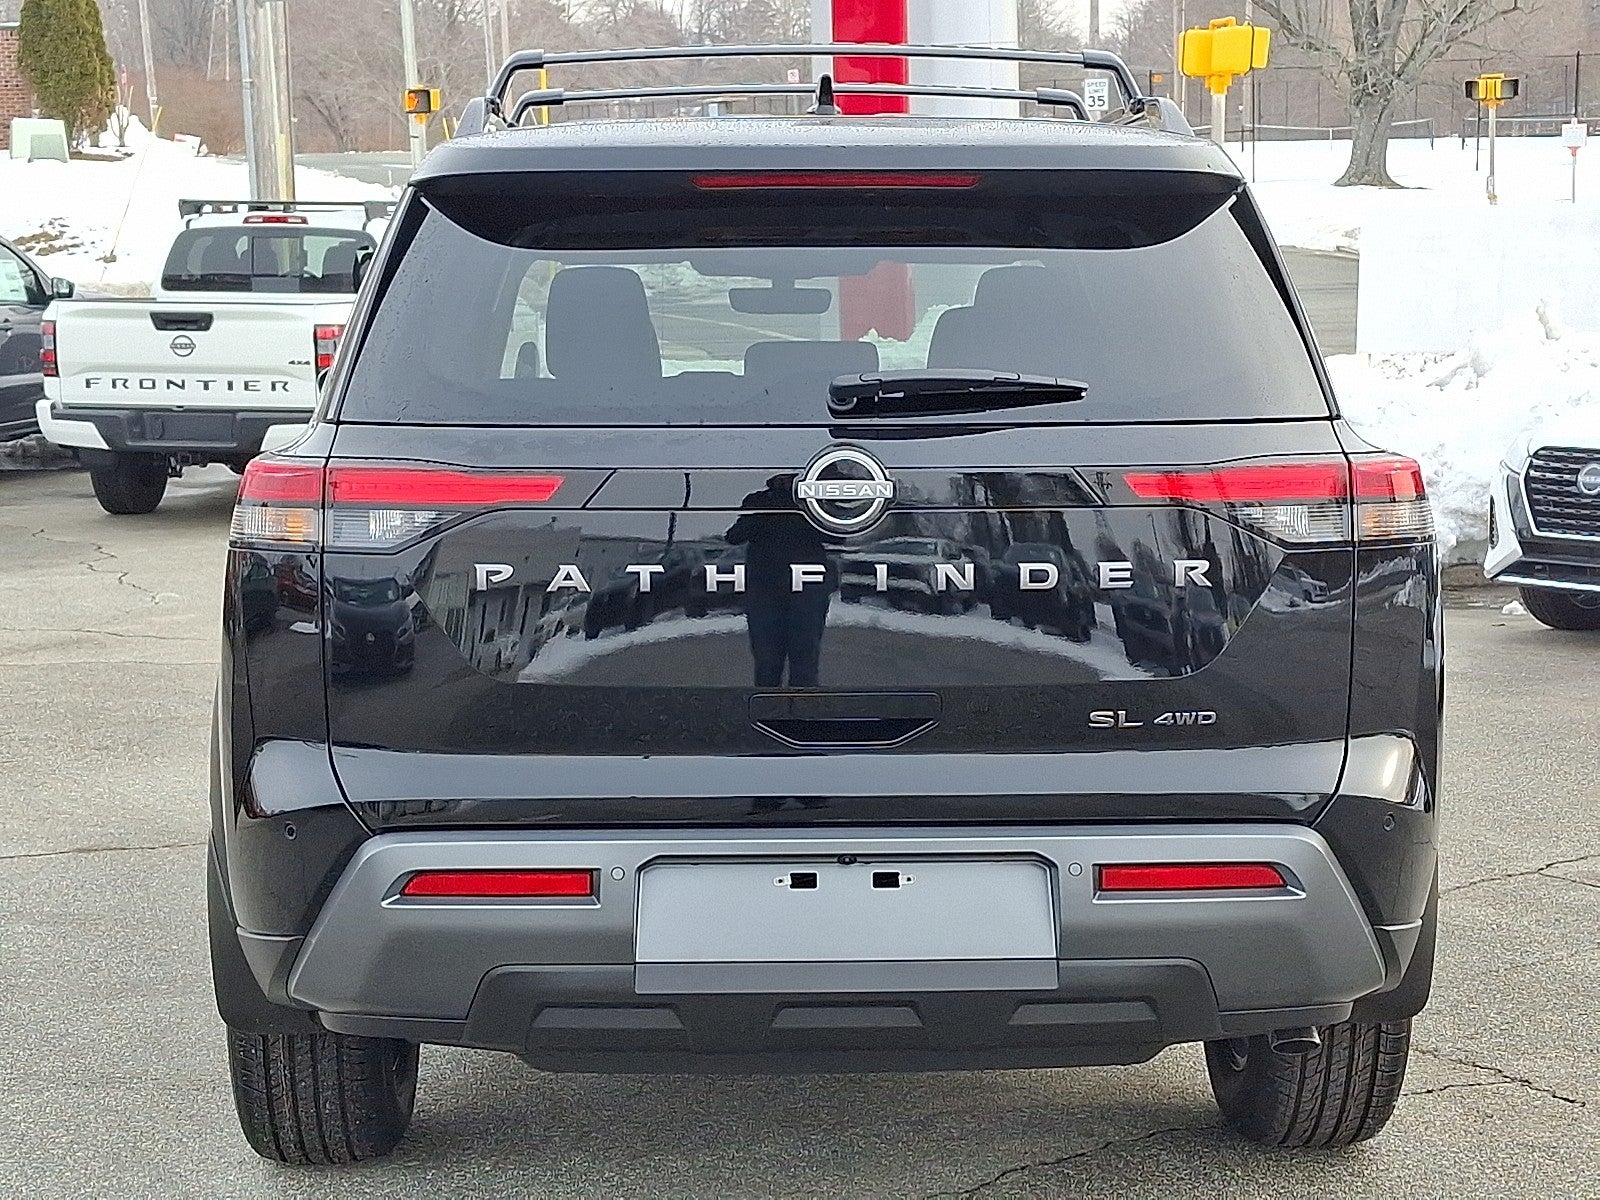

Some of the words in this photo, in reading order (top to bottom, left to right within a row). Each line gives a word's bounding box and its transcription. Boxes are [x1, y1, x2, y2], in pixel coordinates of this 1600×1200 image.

[1087, 96, 1105, 107] 35
[85, 377, 290, 392] FRONTIER
[800, 484, 892, 497] NISSAN
[474, 559, 1213, 593] PATHFINDER
[1088, 710, 1144, 728] SL
[1153, 711, 1217, 726] 4WD
